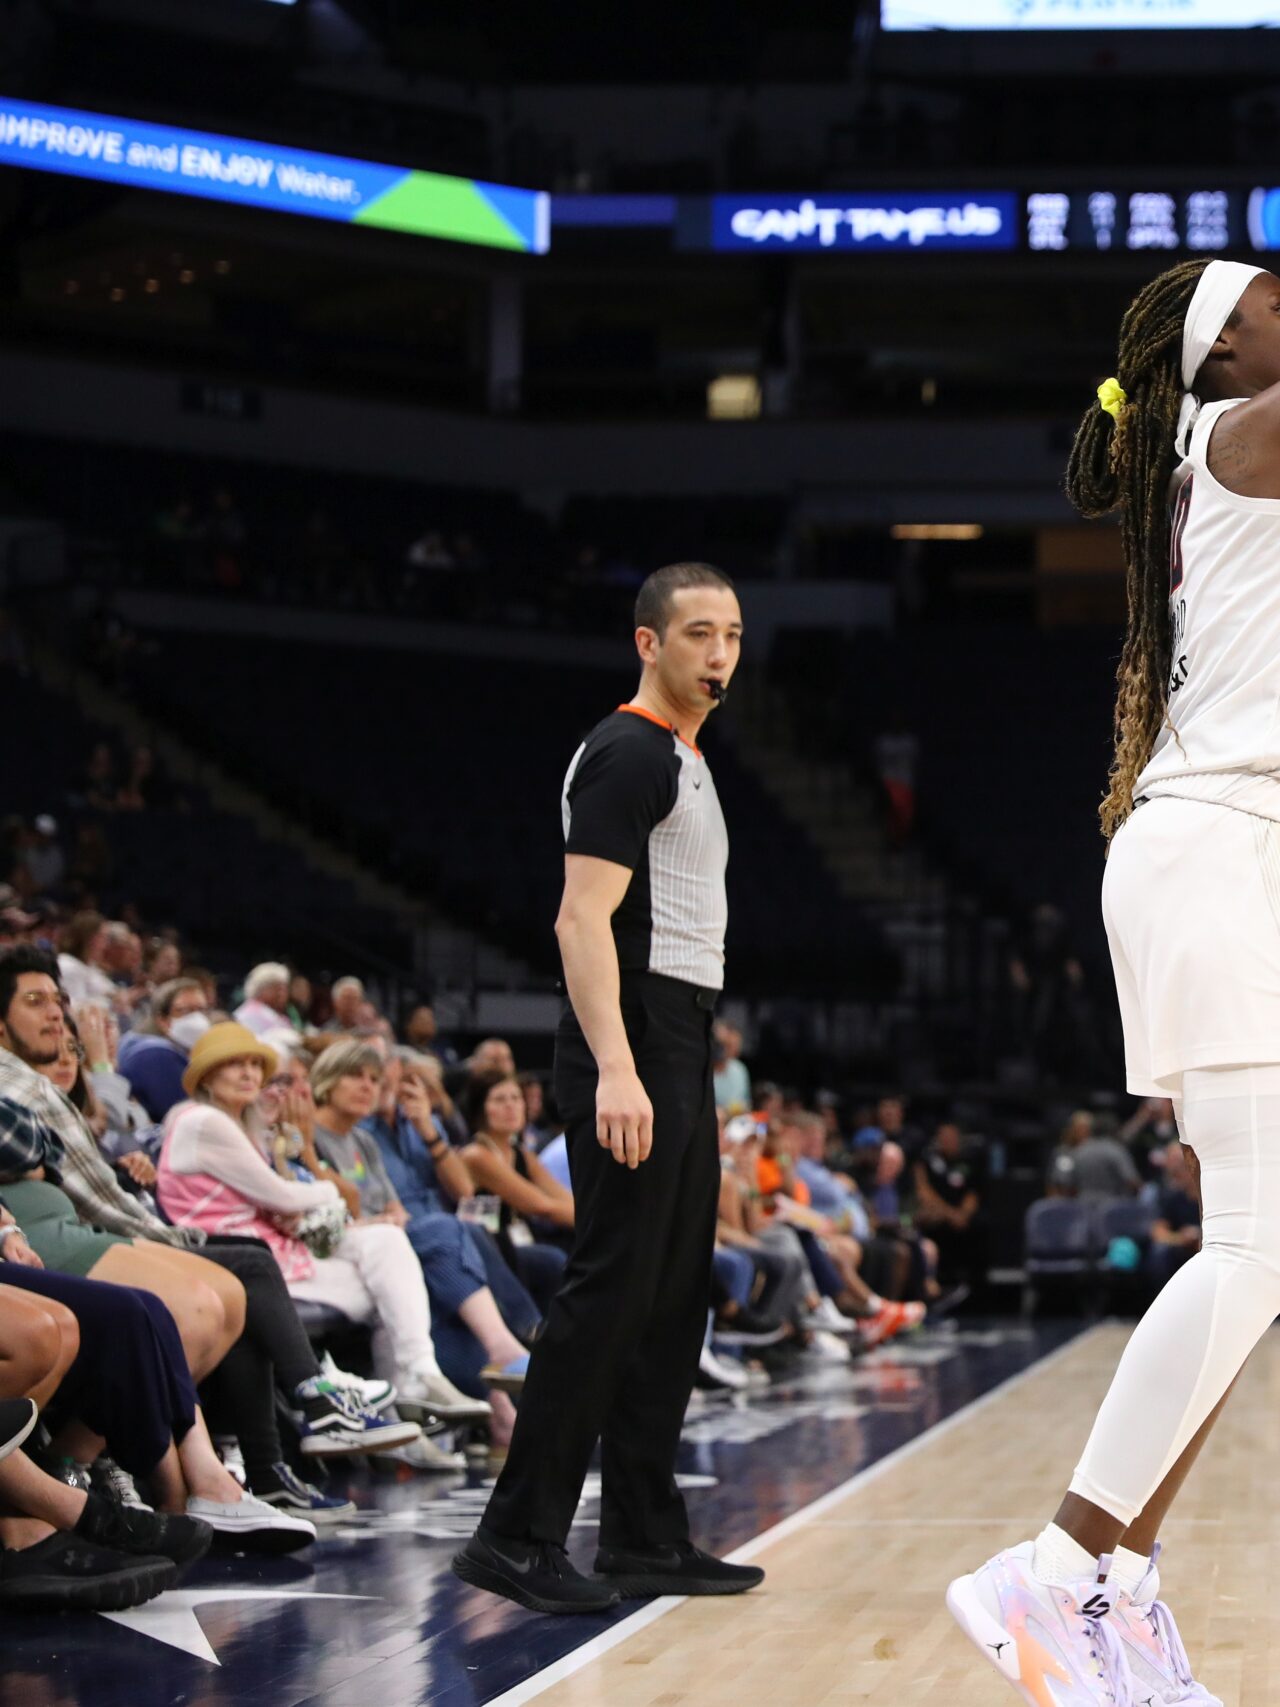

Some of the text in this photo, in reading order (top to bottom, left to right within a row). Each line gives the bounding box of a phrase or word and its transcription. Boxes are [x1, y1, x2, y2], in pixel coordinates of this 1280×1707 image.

[0, 112, 124, 164] IMPROVE
[126, 141, 178, 173] and
[181, 144, 274, 188] ENJOY
